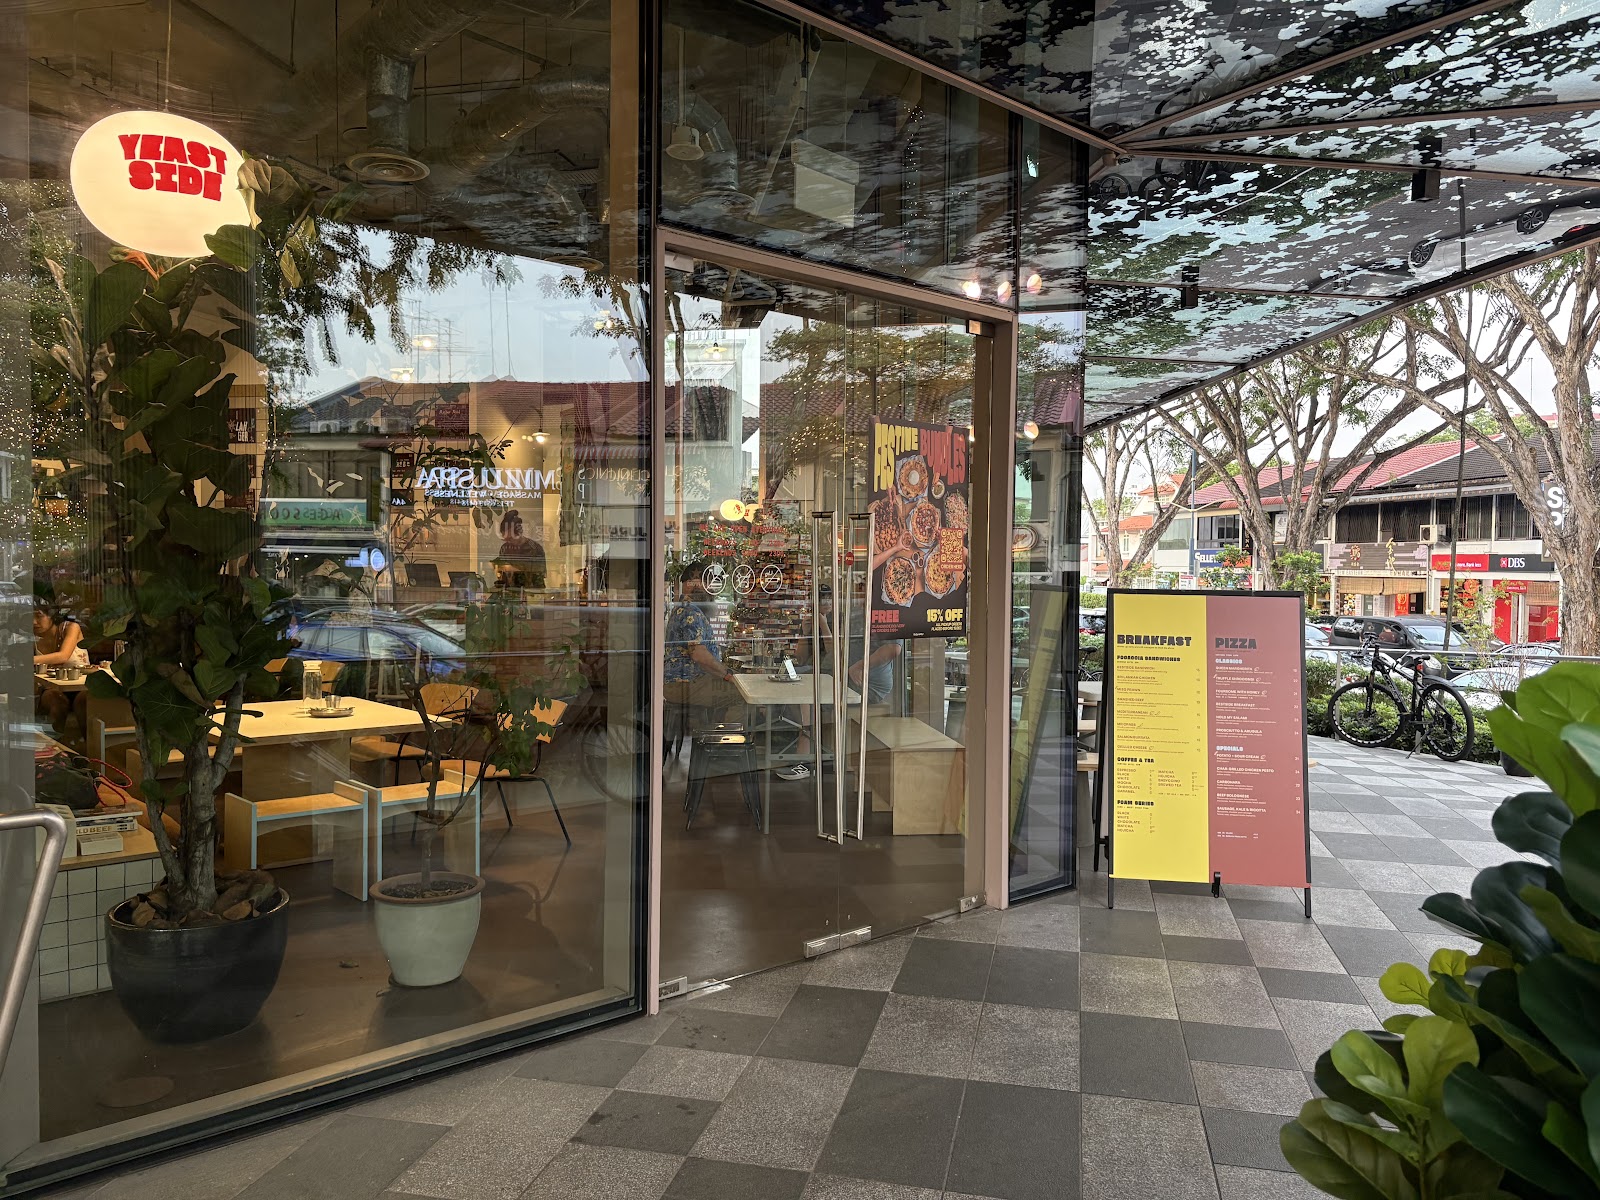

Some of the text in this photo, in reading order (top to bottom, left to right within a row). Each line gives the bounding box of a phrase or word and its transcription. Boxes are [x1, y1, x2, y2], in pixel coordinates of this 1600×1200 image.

[118, 134, 227, 175] YEAST
[129, 160, 222, 201] SIDE
[874, 422, 966, 493] FESTIVE BUNDLES
[731, 525, 747, 533] OPEN
[1508, 557, 1526, 568] DBS
[871, 609, 900, 623] FREE
[926, 609, 963, 623] 15% OFF
[1116, 634, 1192, 647] BREAKFAST
[1215, 637, 1257, 650] PIZZA
[90, 825, 113, 833] BEEF
